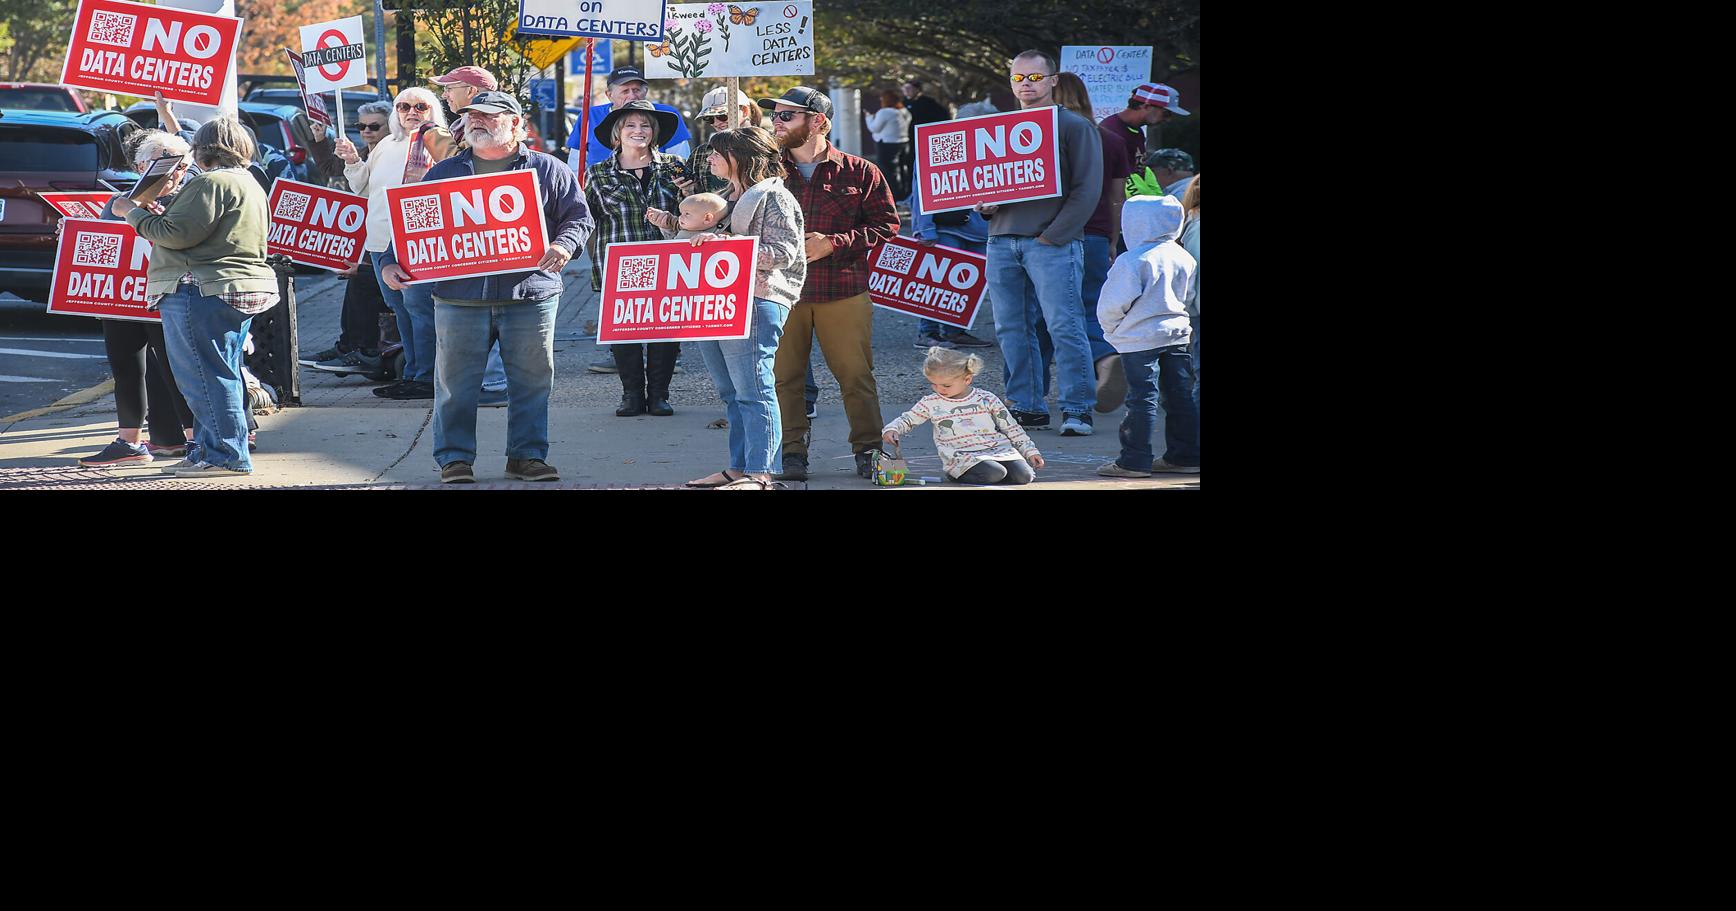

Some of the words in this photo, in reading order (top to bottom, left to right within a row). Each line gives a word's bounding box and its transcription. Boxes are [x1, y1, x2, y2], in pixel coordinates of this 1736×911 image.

[580, 1, 603, 13] on
[667, 9, 705, 19] lkweed
[141, 17, 222, 59] NO
[523, 14, 568, 30] DATA
[576, 19, 659, 36] CENTERS
[756, 22, 791, 37] LESS
[303, 52, 324, 67] DATA
[326, 44, 362, 62] CENTERS
[752, 46, 811, 66] CENTERS
[763, 36, 797, 50] DATA
[1076, 49, 1095, 60] DATA
[1116, 49, 1148, 59] CENTER
[80, 48, 126, 76] DATA
[130, 56, 214, 89] CENTERS
[1088, 74, 1125, 82] ELECTRIC
[1088, 85, 1113, 93] WATER
[974, 121, 1043, 161] NO
[930, 169, 970, 196] DATA
[973, 158, 1045, 190] CENTERS
[309, 197, 365, 232] NO
[450, 185, 525, 228] NO
[130, 236, 153, 270] N
[268, 222, 298, 246] DATA
[298, 228, 356, 258] CENTERS
[406, 236, 448, 266] DATA
[452, 226, 532, 260] CENTERS
[666, 250, 740, 290] NO
[916, 252, 980, 290] NO
[67, 272, 114, 299] DATA
[120, 276, 148, 302] CE
[868, 272, 902, 296] DATA
[904, 282, 969, 313] CENTERS
[613, 297, 654, 324] DATA
[659, 294, 737, 323] CENTERS
